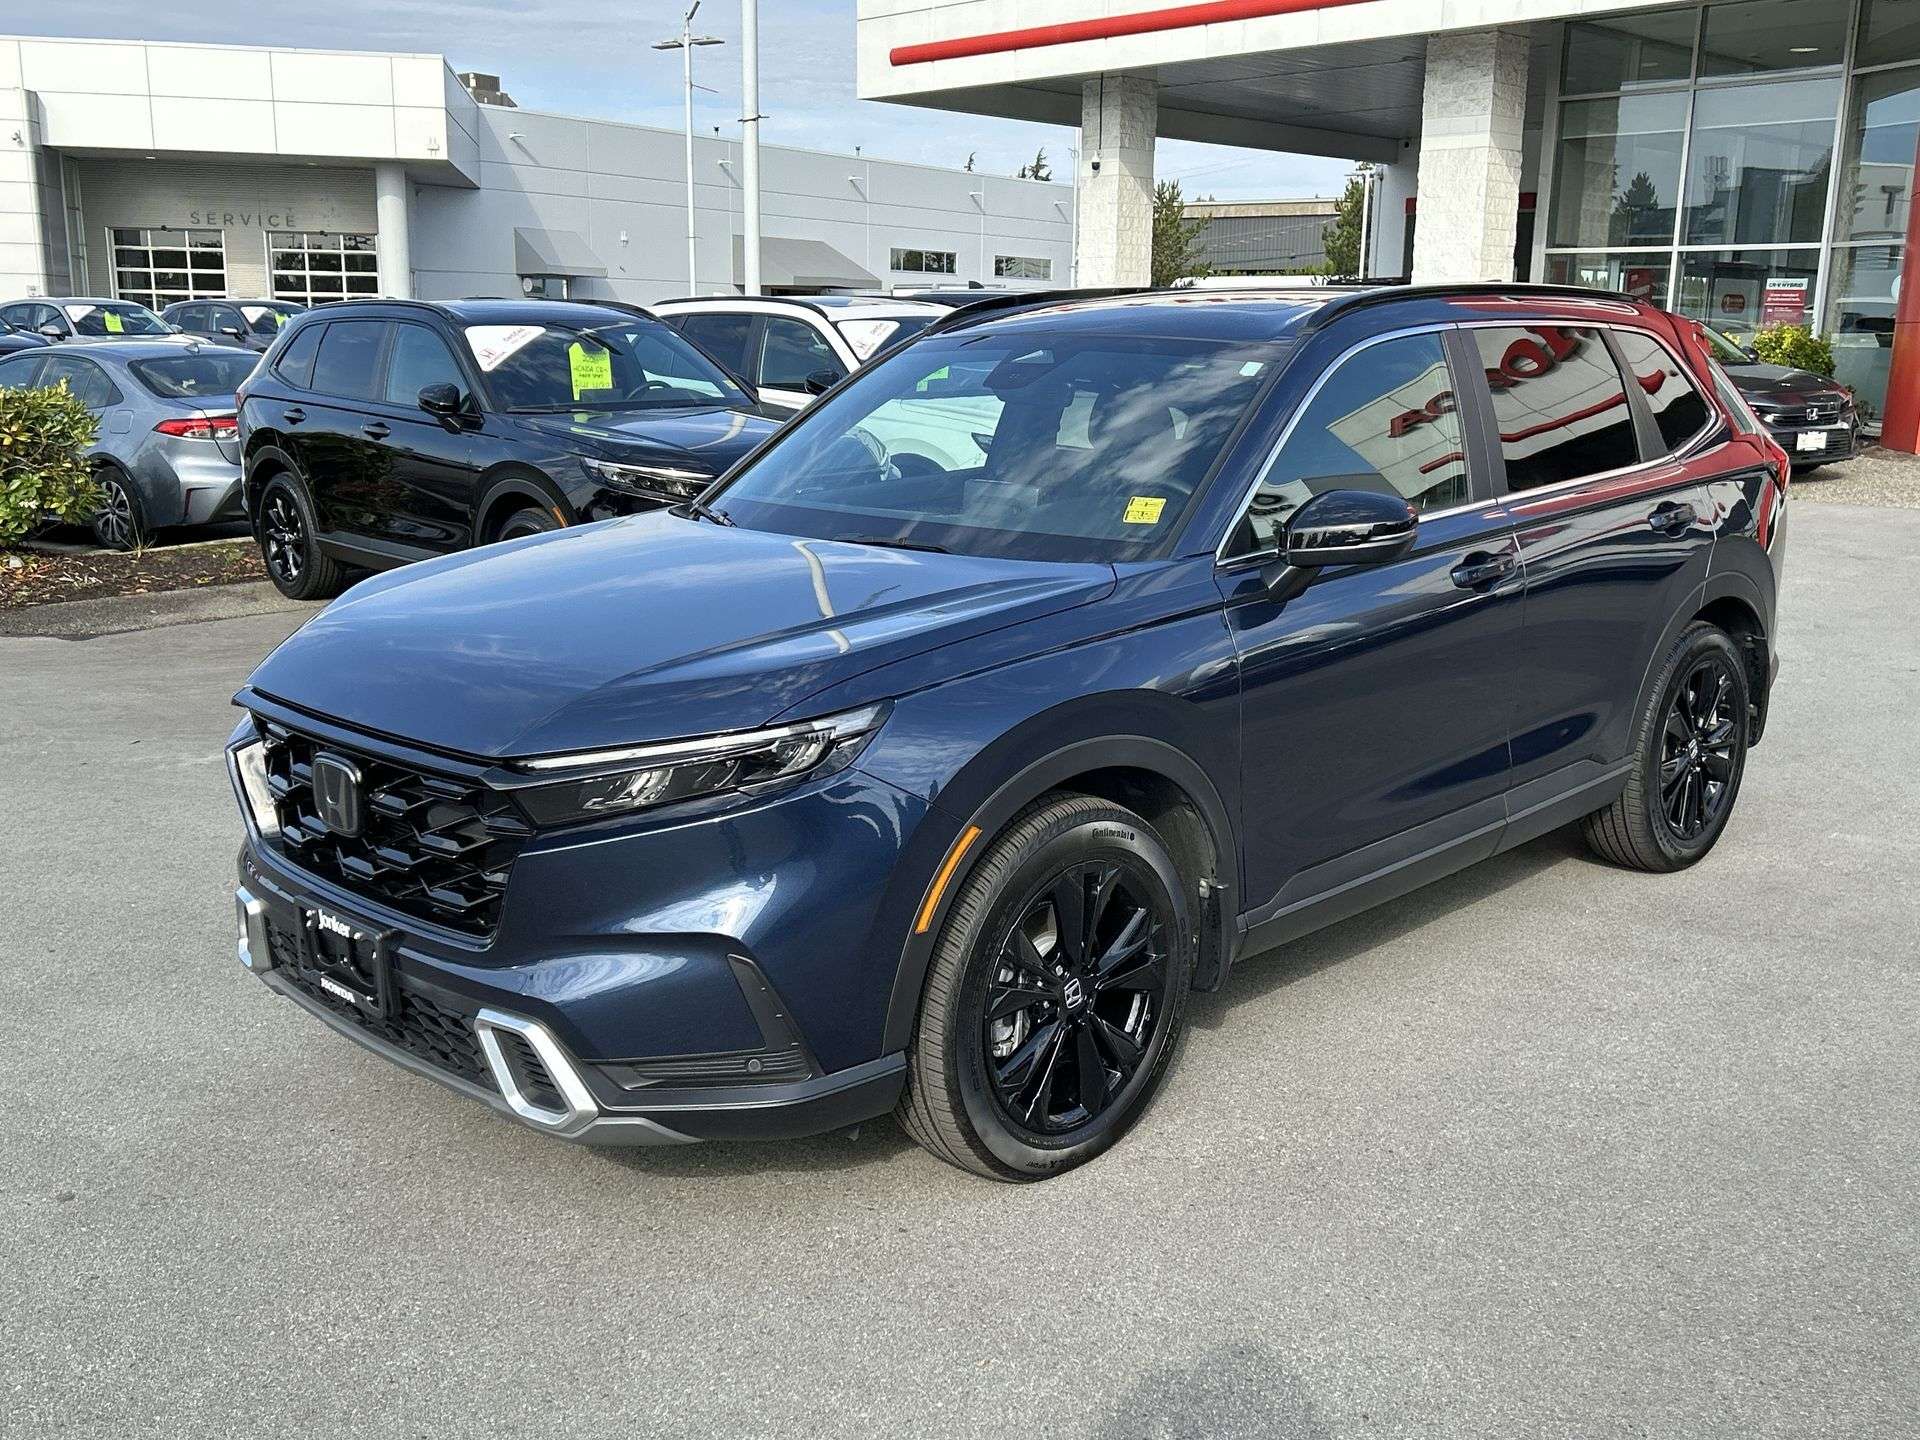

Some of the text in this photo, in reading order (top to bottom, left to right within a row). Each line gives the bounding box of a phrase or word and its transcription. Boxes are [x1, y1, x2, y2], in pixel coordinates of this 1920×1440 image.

[190, 211, 296, 227] SERVICE
[1092, 827, 1130, 840] Continental
[317, 908, 351, 938] Jonker
[320, 977, 356, 1003] HONDA
